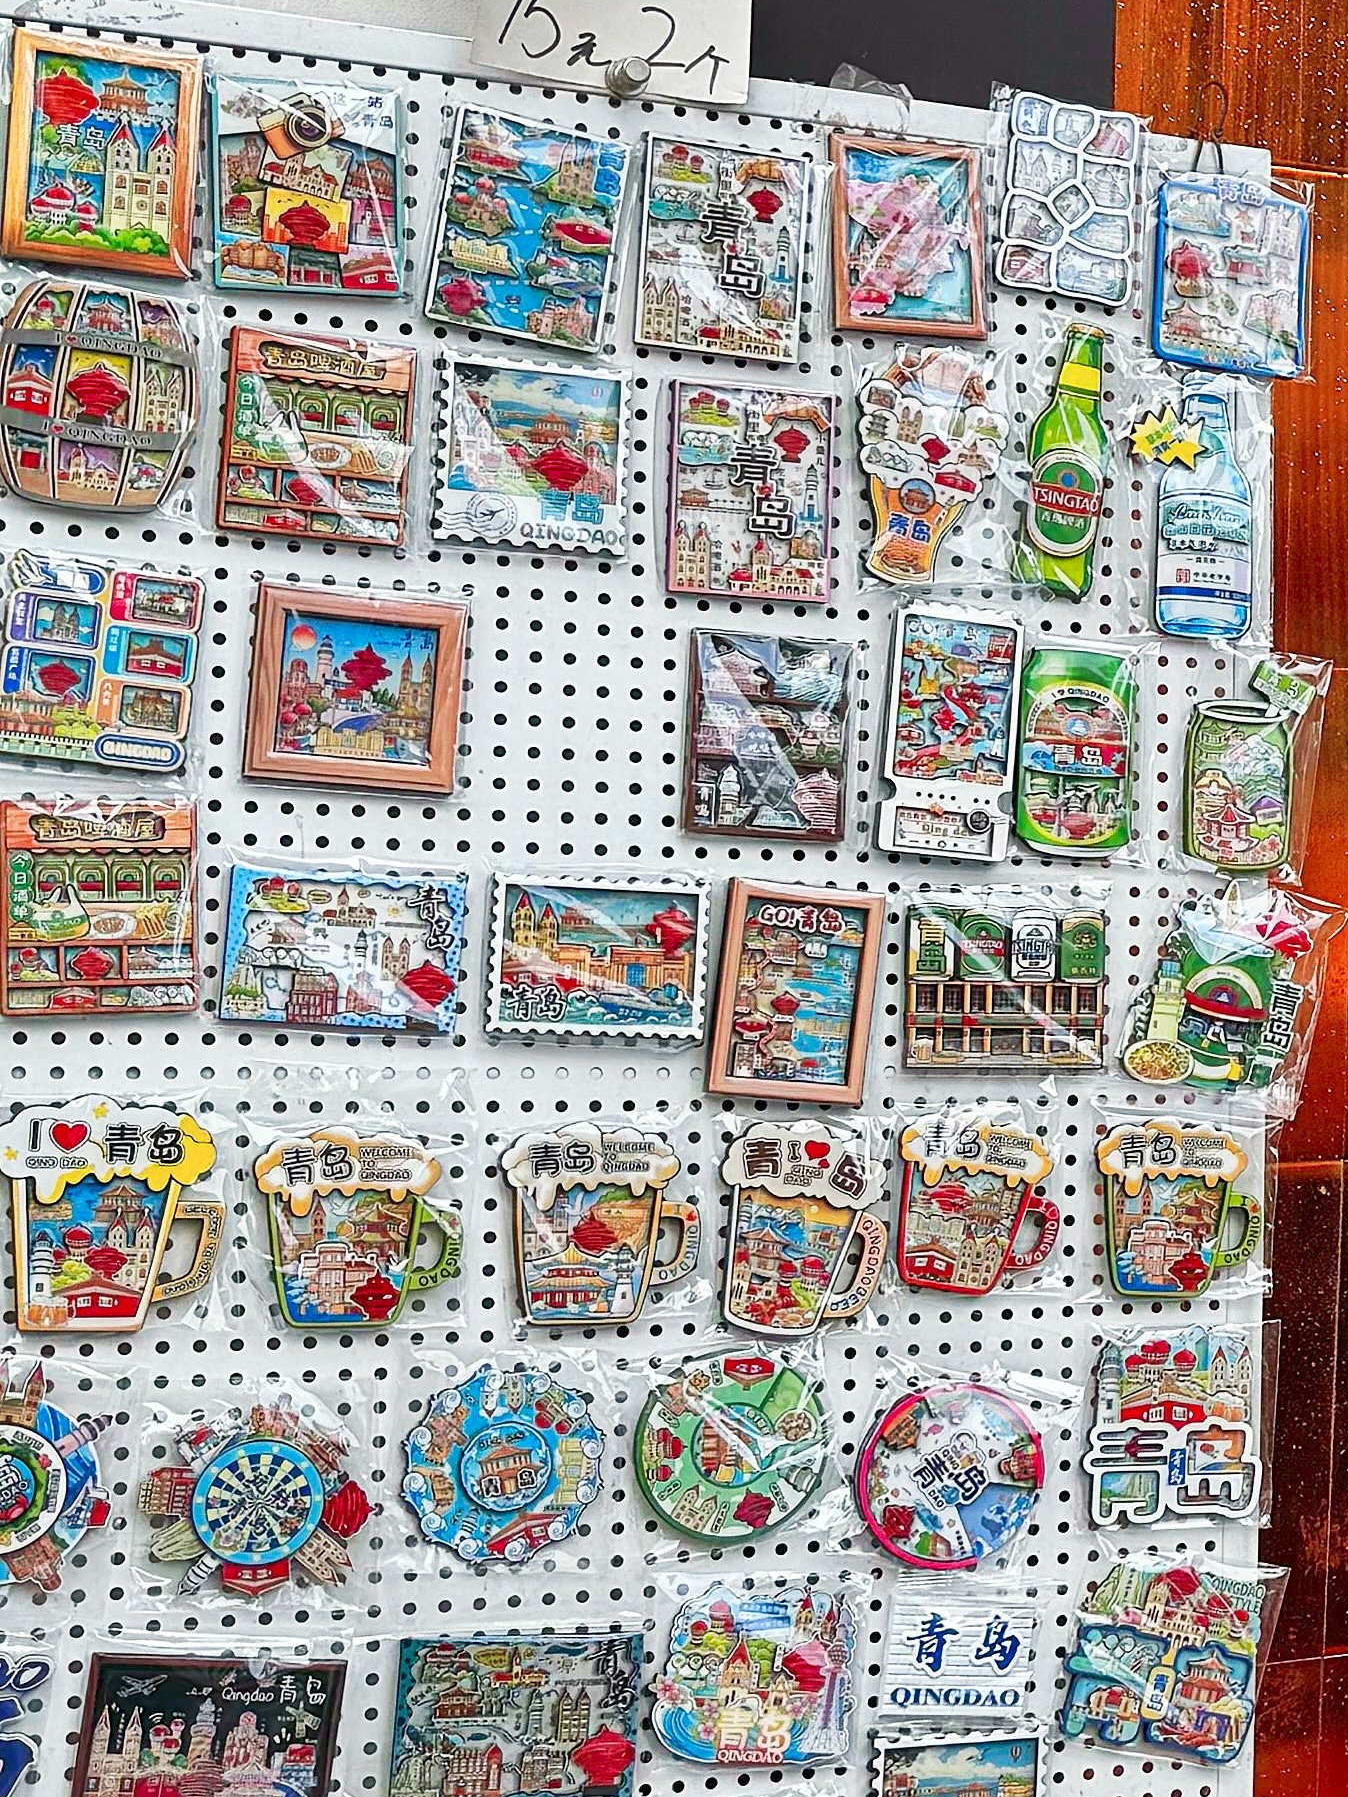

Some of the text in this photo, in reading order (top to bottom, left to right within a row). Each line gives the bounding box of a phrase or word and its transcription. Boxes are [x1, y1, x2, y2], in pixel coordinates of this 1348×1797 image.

[56, 122, 106, 152] 青岛
[701, 199, 767, 299] 青岛
[80, 335, 164, 360] QINGDAO
[66, 425, 153, 449] QINGDAO
[538, 490, 605, 524] 青岛
[728, 442, 798, 540] 青岛
[1032, 484, 1100, 514] TSINGTAO
[519, 523, 618, 546] QINGDAO
[887, 513, 933, 544] 青岛
[1052, 743, 1103, 769] 青岛
[12, 854, 30, 920] 今日酒单
[408, 883, 457, 953] 青岛
[506, 983, 567, 1023] 青岛
[28, 1118, 185, 1166] I 青岛
[359, 1145, 412, 1159] WELCOME
[603, 1140, 656, 1153] WELCOME
[923, 1119, 982, 1161] 青岛
[1120, 1130, 1177, 1168] 青岛
[25, 1156, 88, 1170] QING DAO
[282, 1142, 353, 1185] 青岛
[359, 1168, 413, 1182] QINGDAO
[361, 1158, 377, 1170] TO
[528, 1141, 596, 1178] 青岛
[602, 1160, 650, 1173] QINGDAO
[743, 1139, 869, 1199] 青 I 岛
[658, 1225, 698, 1282] QINGDAO
[1014, 1219, 1059, 1266] QINGDAO
[1223, 1214, 1261, 1264] QINGDAO
[417, 1229, 463, 1287] QINGDAO
[1211, 1574, 1267, 1600] QINGDAO
[905, 1612, 1022, 1677] 青岛
[221, 1674, 328, 1706] Qingdao 青岛
[889, 1686, 1021, 1707] QINGDAO
[716, 1708, 792, 1752] 青岛
[717, 1750, 785, 1765] QINGDAO
